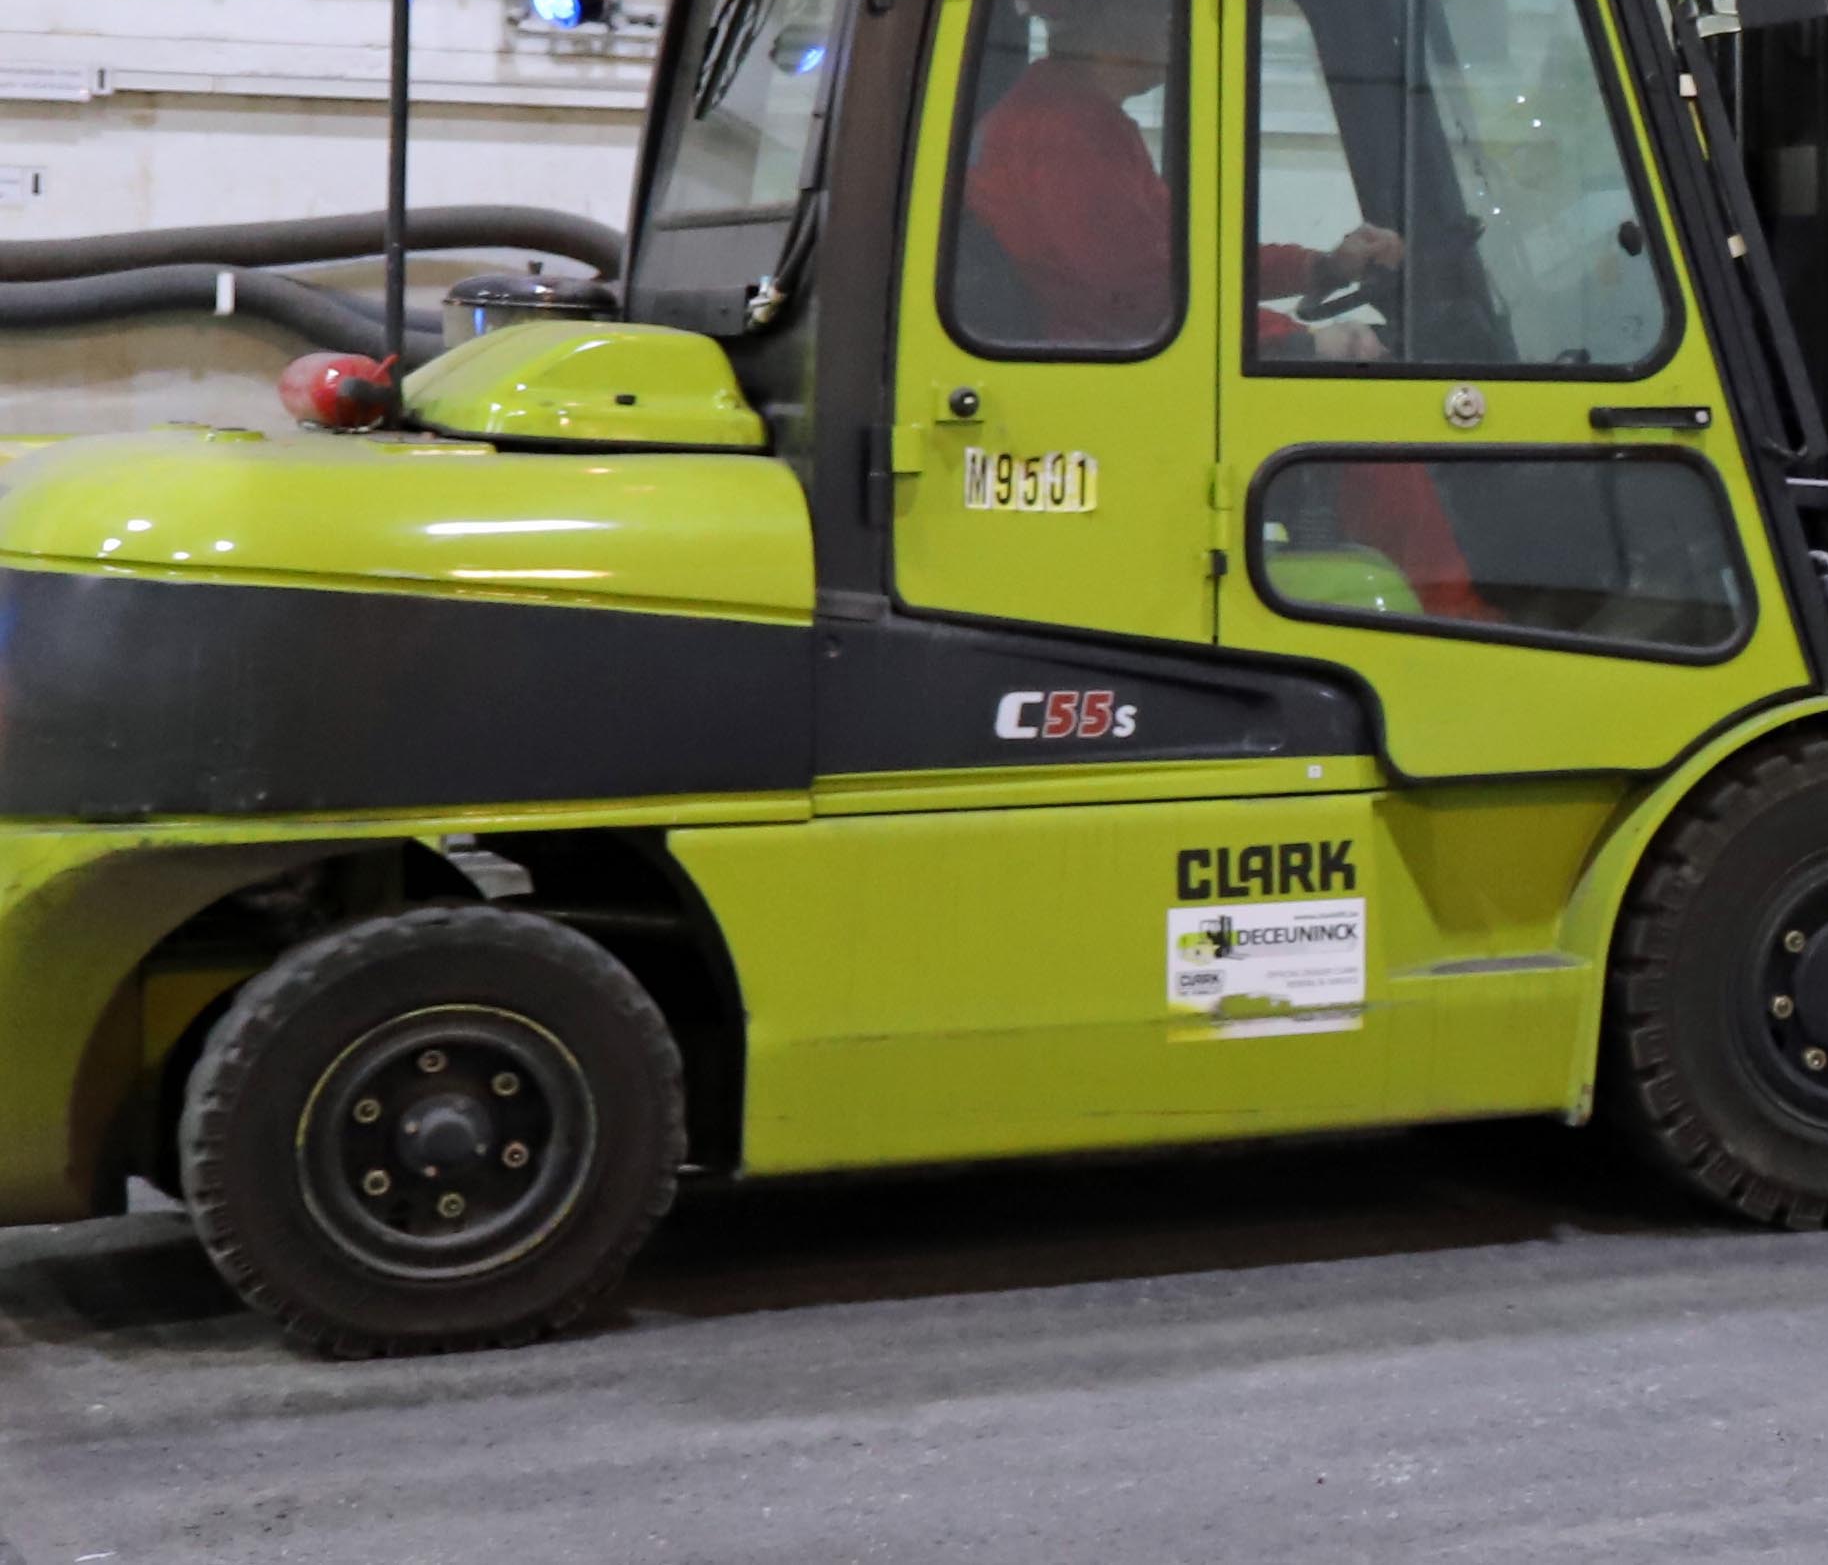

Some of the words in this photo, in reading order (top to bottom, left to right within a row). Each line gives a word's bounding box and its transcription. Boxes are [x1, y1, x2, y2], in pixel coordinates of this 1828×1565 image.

[969, 453, 1087, 506] M9501
[995, 690, 1138, 739] C55s
[1177, 840, 1356, 901] CLARK
[1237, 922, 1358, 947] DECEUNINCK
